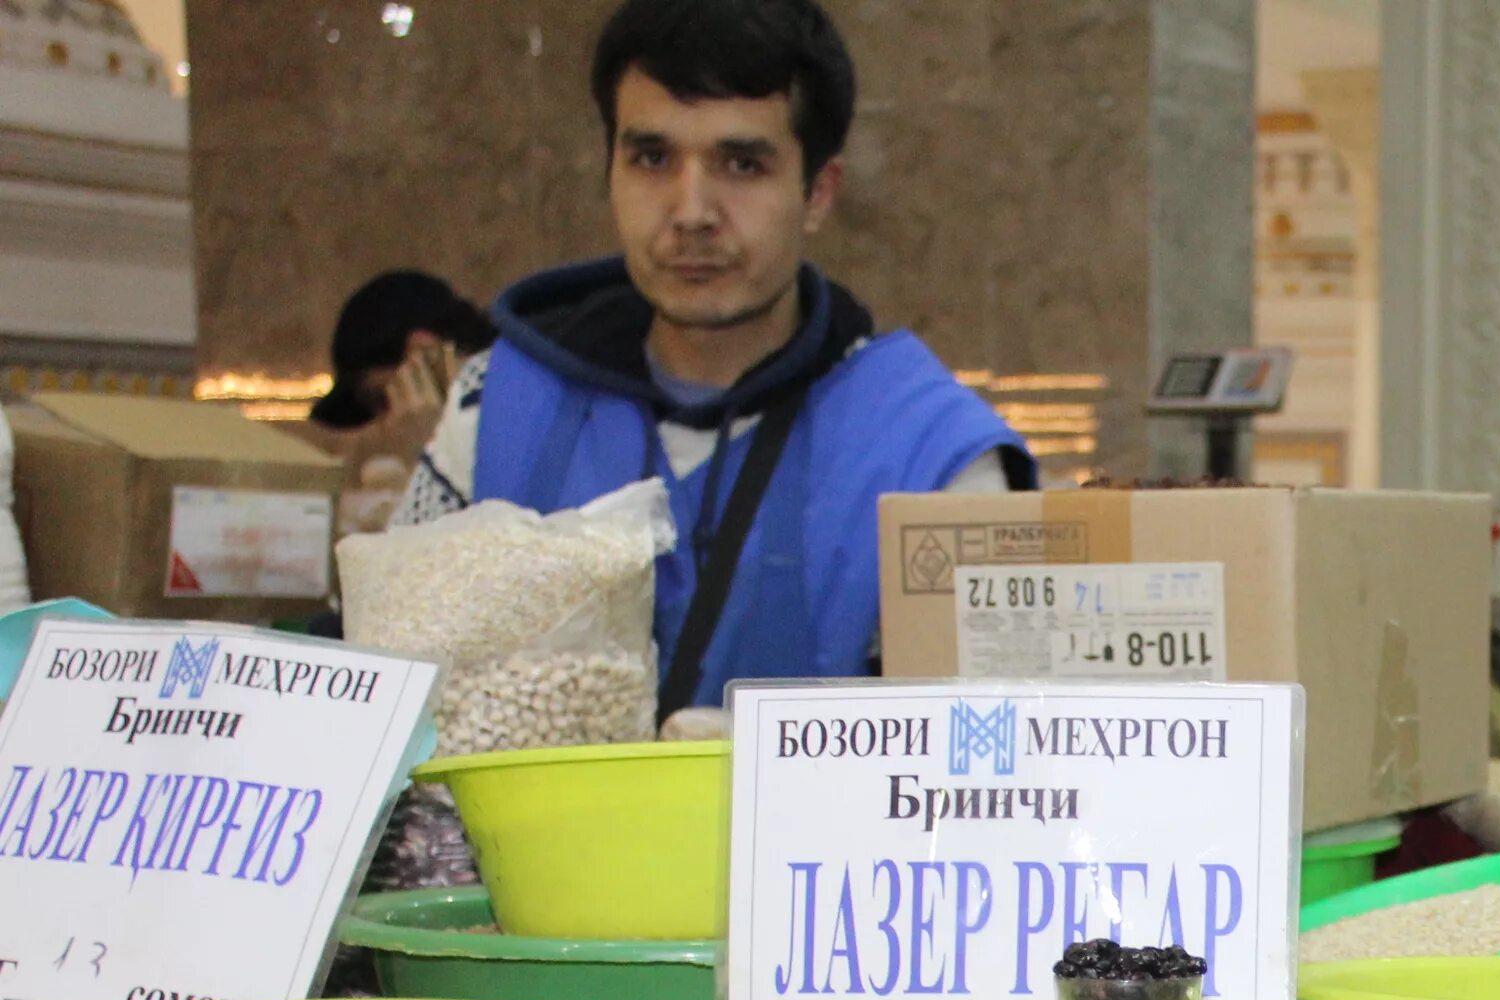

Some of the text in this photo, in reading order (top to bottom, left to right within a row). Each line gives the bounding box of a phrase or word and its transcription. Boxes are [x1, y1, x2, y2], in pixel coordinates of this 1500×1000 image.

[45, 648, 160, 683] БОЗОРИ
[1127, 631, 1213, 667] 110-8
[776, 717, 1229, 765] БОЗОРИ МЕҲРГОН
[774, 858, 994, 997] ЛАЗЕР
